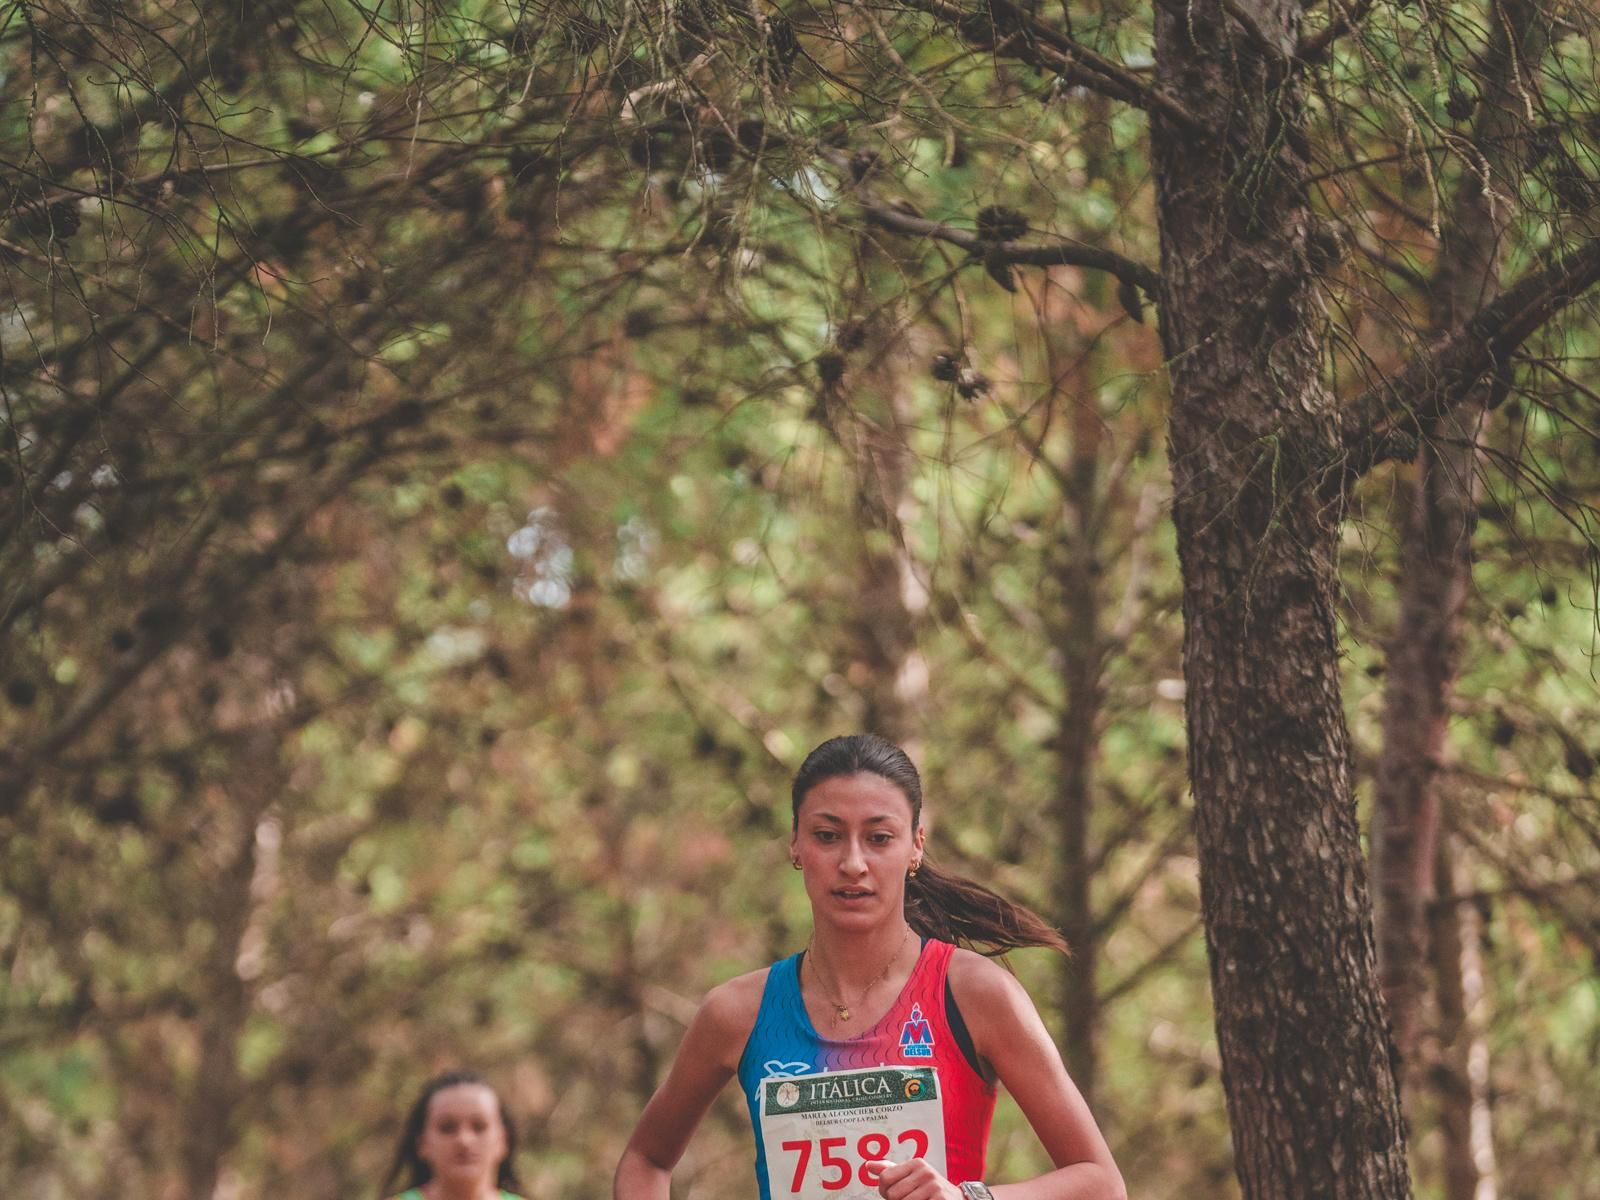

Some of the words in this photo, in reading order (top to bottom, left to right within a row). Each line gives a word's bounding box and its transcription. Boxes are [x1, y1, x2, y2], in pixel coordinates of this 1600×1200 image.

[810, 1077, 892, 1100] ITÁLICA
[801, 1110, 828, 1120] MARTA
[876, 1105, 903, 1114] CORZO
